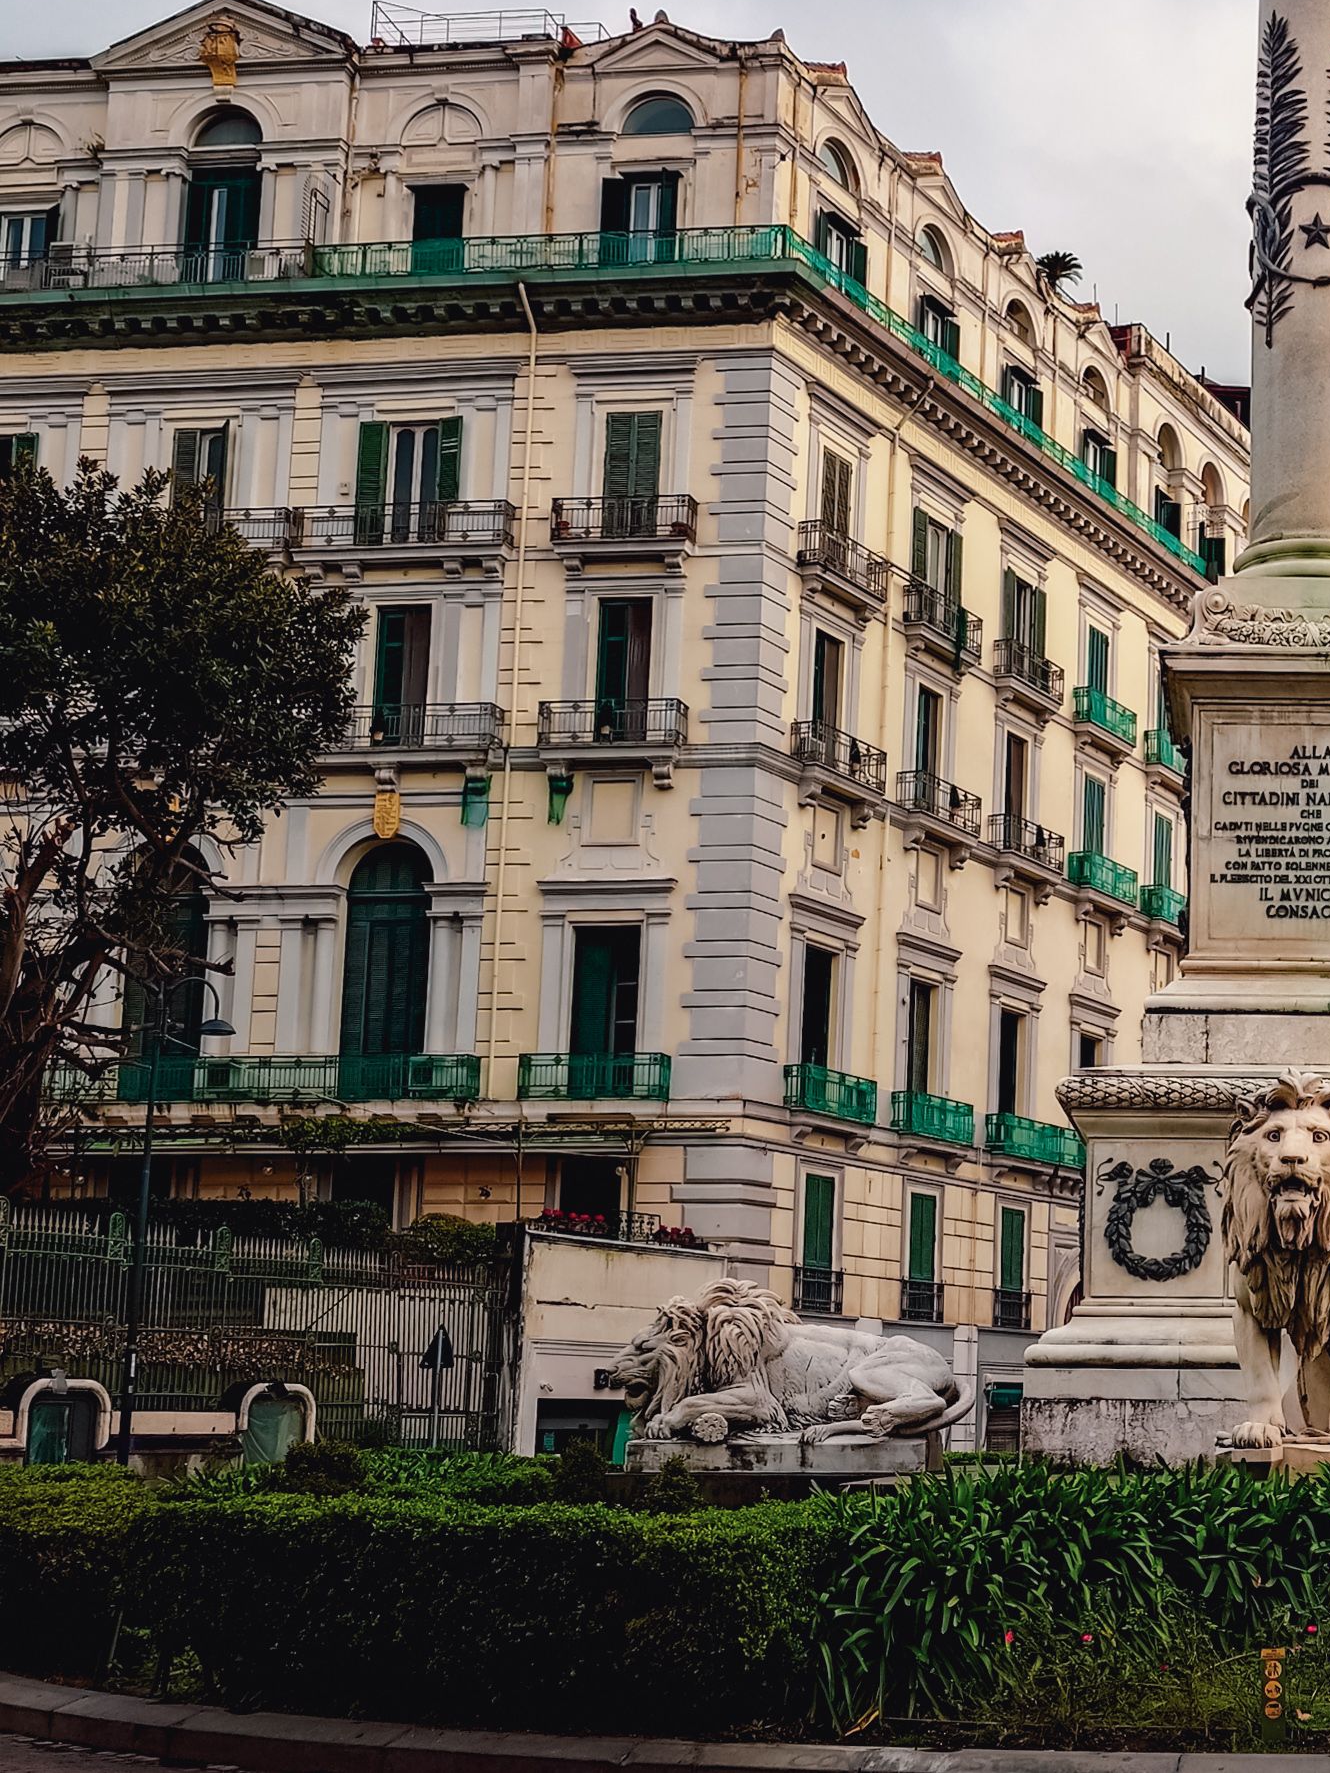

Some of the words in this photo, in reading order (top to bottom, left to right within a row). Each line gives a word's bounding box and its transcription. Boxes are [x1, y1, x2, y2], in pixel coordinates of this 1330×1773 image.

[1228, 761, 1312, 776] GLORIOSA
[1301, 779, 1319, 789] DEI
[1222, 791, 1300, 806] CITTADINI
[1300, 809, 1322, 819] CHE
[1214, 821, 1253, 831] CADVTI
[1254, 822, 1287, 832] NELLE
[1289, 822, 1323, 832] PVGNE
[1235, 835, 1324, 845] RIVENDICARONO
[1238, 848, 1251, 857] LA
[1299, 848, 1309, 858] DI
[1225, 861, 1247, 871] CON
[1250, 861, 1282, 871] PATTO
[1210, 874, 1218, 883] IL
[1274, 875, 1292, 884] DEL
[1294, 875, 1312, 884] XXI
[1259, 887, 1274, 901] IL
